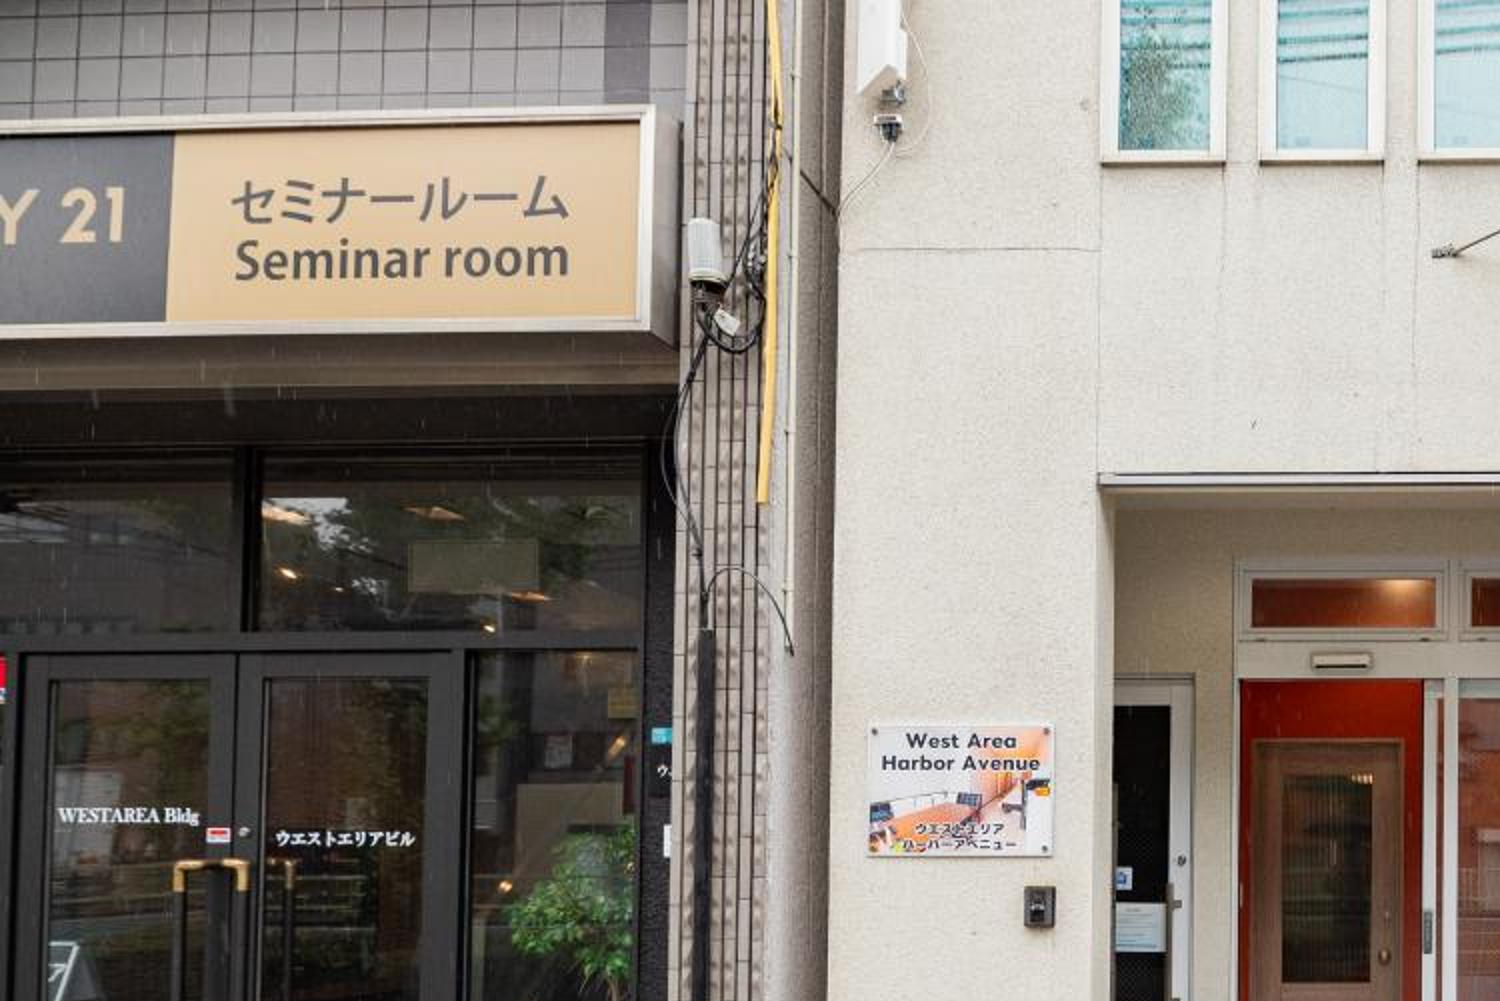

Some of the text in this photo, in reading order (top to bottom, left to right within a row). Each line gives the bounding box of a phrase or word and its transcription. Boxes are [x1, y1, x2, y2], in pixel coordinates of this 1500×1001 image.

[231, 175, 569, 224] セミナールーム
[60, 187, 125, 243] 21
[235, 237, 568, 280] Seminar room
[906, 733, 1017, 749] West Area
[882, 755, 1041, 771] Harbor Avenue
[57, 807, 200, 827] WESTAREA Bldg
[275, 830, 416, 847] ウエストエリアビル
